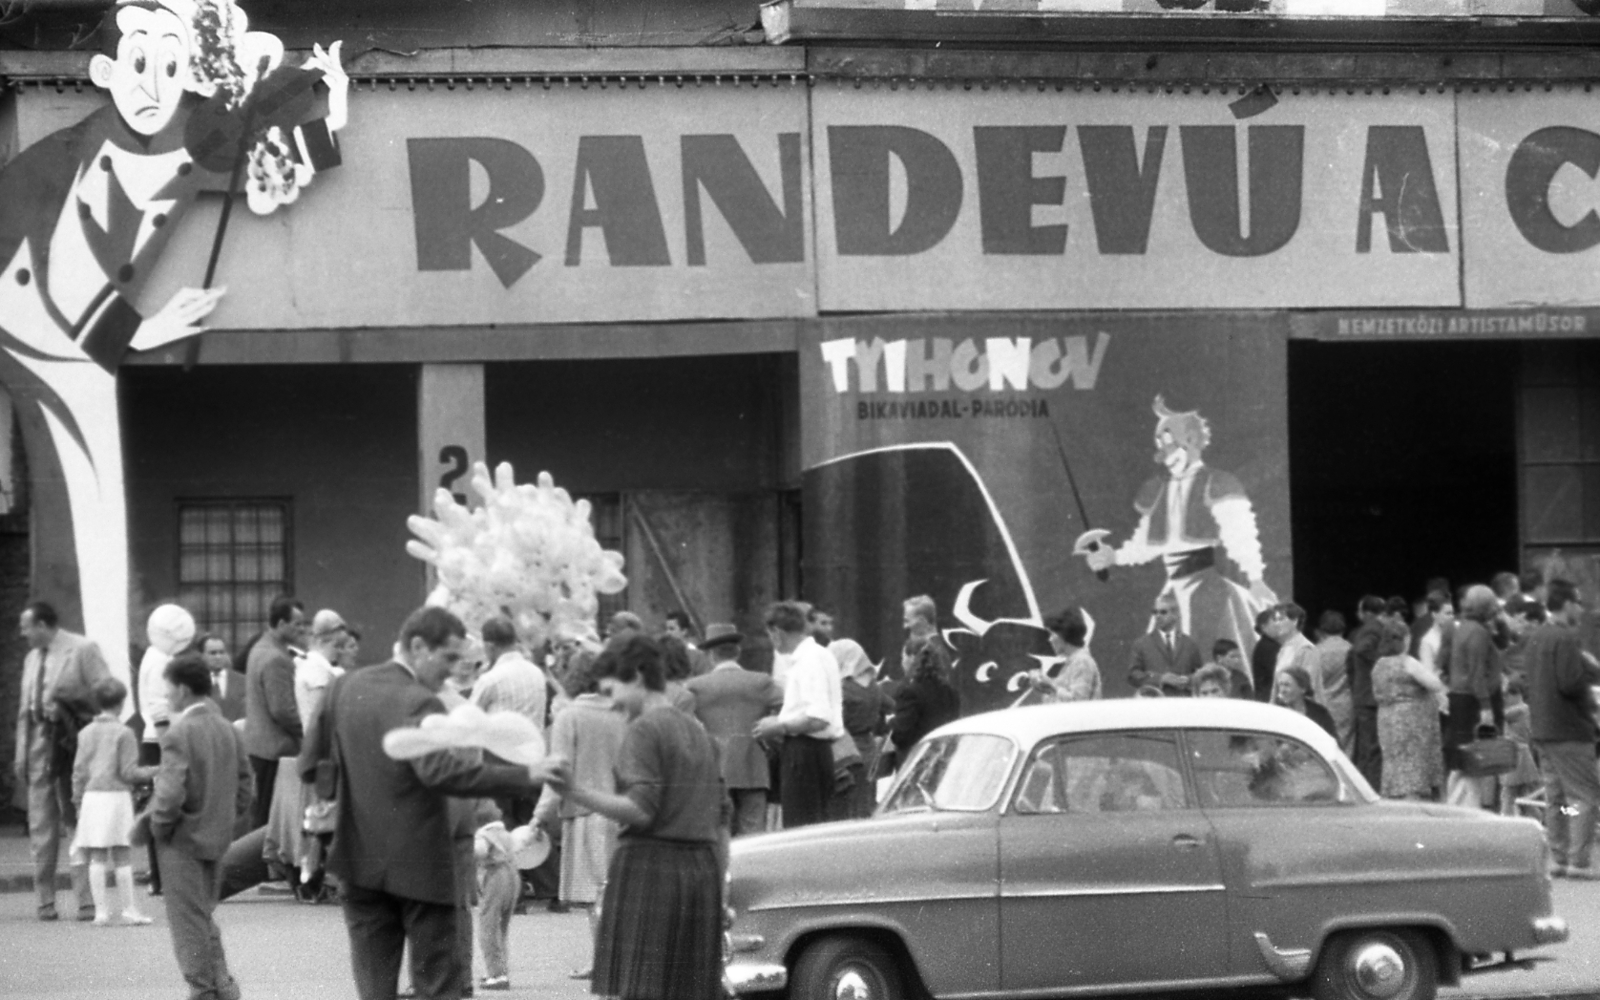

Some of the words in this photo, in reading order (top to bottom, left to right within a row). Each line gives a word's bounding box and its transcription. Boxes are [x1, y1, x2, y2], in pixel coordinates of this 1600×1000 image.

[405, 83, 1306, 290] RANDEVÚ
[1355, 124, 1450, 254] A
[1505, 125, 1600, 255] C
[820, 331, 1112, 393] TYIHONOV
[438, 444, 469, 507] 2
